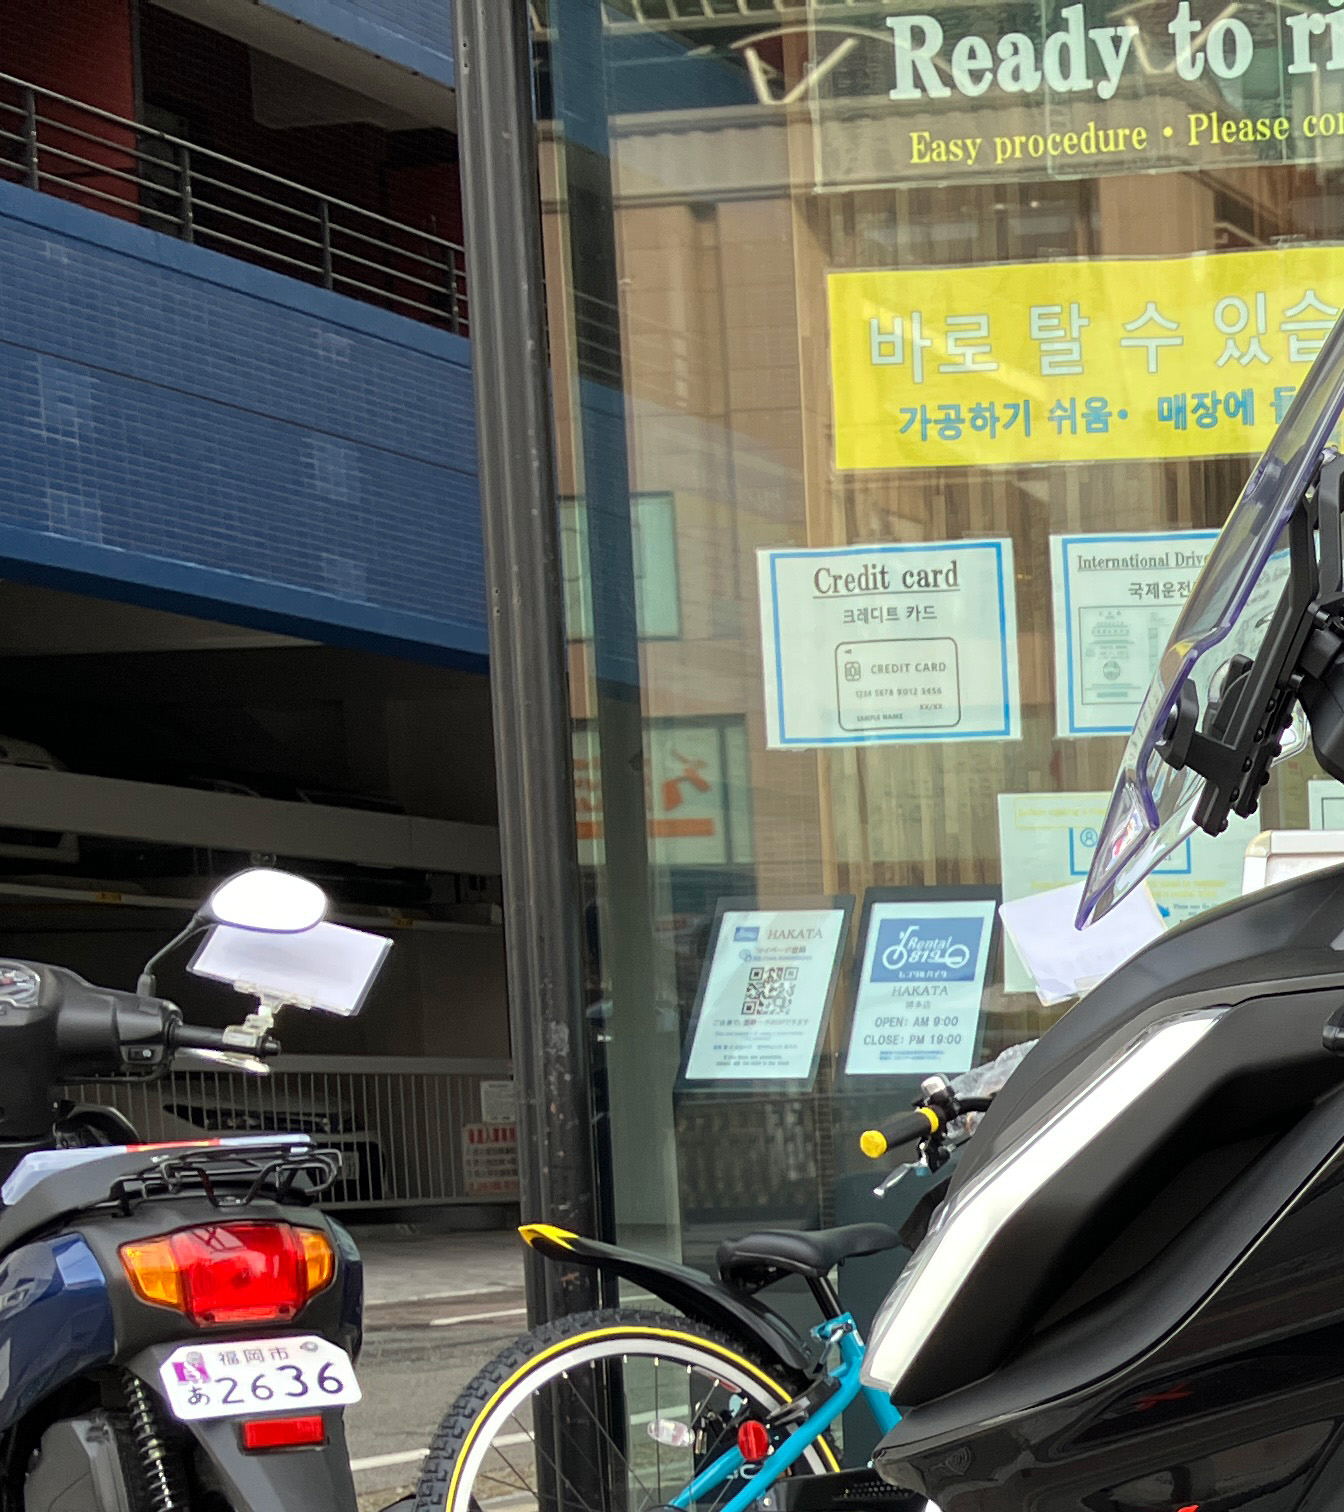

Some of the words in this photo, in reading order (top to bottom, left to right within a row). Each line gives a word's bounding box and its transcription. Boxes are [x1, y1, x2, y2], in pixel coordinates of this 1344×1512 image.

[886, 3, 1139, 100] Ready
[1168, 1, 1253, 81] to
[910, 131, 982, 165] Easy
[994, 121, 1147, 165] procedure
[1188, 110, 1290, 146] Please
[869, 311, 999, 384] 바로
[1029, 302, 1090, 377] 탈
[1119, 301, 1184, 375] 수
[899, 398, 1032, 442] 가공하기
[1157, 388, 1255, 432] 매장에
[1077, 552, 1169, 570] International
[813, 563, 890, 595] Credit
[901, 560, 959, 590] card
[1128, 581, 1196, 600] 국제운전
[843, 606, 900, 624] 크레디트
[906, 604, 937, 622] 카드
[871, 663, 911, 675] CREDIT
[915, 662, 946, 673] CARD
[767, 928, 823, 940] HAKATA
[908, 936, 953, 950] Rental
[908, 950, 942, 963] 819
[891, 985, 949, 997] HAKATA
[874, 1016, 909, 1028] OPEN:
[912, 1016, 929, 1027] AM
[933, 1015, 959, 1027] 9:00
[863, 1034, 905, 1046] CLOSE:
[908, 1034, 925, 1045] PM
[930, 1033, 962, 1045] 19:00
[218, 1348, 289, 1366] 福岡市
[187, 1385, 211, 1406] あ
[213, 1361, 344, 1405] 2636
